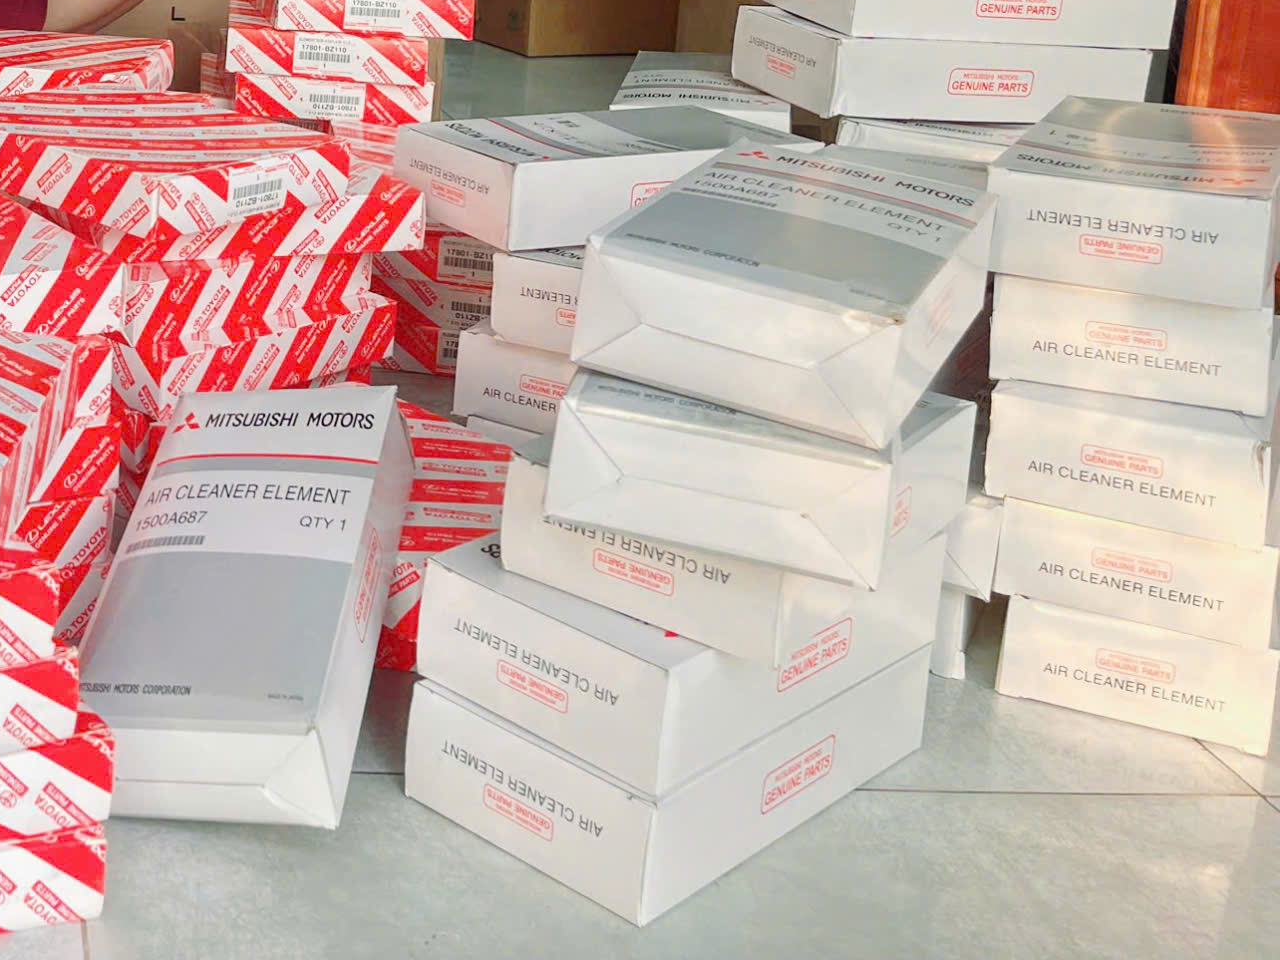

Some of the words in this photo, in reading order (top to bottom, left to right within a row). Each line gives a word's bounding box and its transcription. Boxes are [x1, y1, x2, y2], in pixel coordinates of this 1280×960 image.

[980, 3, 1024, 15] GENUINE
[1026, 5, 1057, 17] PARTS
[951, 80, 995, 92] GENUINE
[998, 82, 1029, 94] PARTS
[776, 155, 886, 183] MITSUBISHI
[894, 179, 975, 208] MOTORS
[703, 171, 737, 185] AIR
[737, 175, 839, 203] CLEANER
[842, 200, 944, 232] ELEMENT
[1026, 208, 1104, 231] ELEMENT
[1108, 218, 1187, 241] CLEANER
[1192, 230, 1220, 245] AIR
[446, 248, 494, 262] 17801-BZ11
[520, 287, 571, 305] ELEMENT
[1032, 340, 1059, 354] AIR
[1063, 344, 1140, 366] CLEANER
[1143, 355, 1222, 377] ELEMENT
[483, 387, 502, 400] AIR
[503, 391, 557, 413] CLEANER
[205, 412, 300, 428] MITSUBISHI
[306, 411, 376, 430] MOTORS
[144, 487, 173, 506] AIR
[175, 483, 259, 500] CLEANER
[262, 484, 352, 506] ELEMENT
[1027, 459, 1054, 476] AIR
[1057, 465, 1135, 492] CLEANER
[1139, 482, 1217, 507] ELEMENT
[136, 510, 209, 531] 1500A687
[299, 515, 335, 530] QTY
[620, 537, 698, 574] CLEANER
[702, 564, 731, 584] AIR
[1038, 561, 1065, 577] AIR
[1068, 568, 1144, 595] CLEANER
[1148, 585, 1225, 612] ELEMENT
[453, 617, 518, 659] ELEMENT
[521, 647, 590, 693] CLEANER
[114, 683, 140, 695] MOTORS
[593, 685, 620, 706] AIR
[1043, 662, 1069, 678] AIR
[1072, 669, 1147, 695] CLEANER
[1151, 686, 1227, 713] ELEMENT
[440, 739, 505, 785] ELEMENT
[507, 775, 575, 823] CLEANER
[578, 814, 604, 838] AIR
